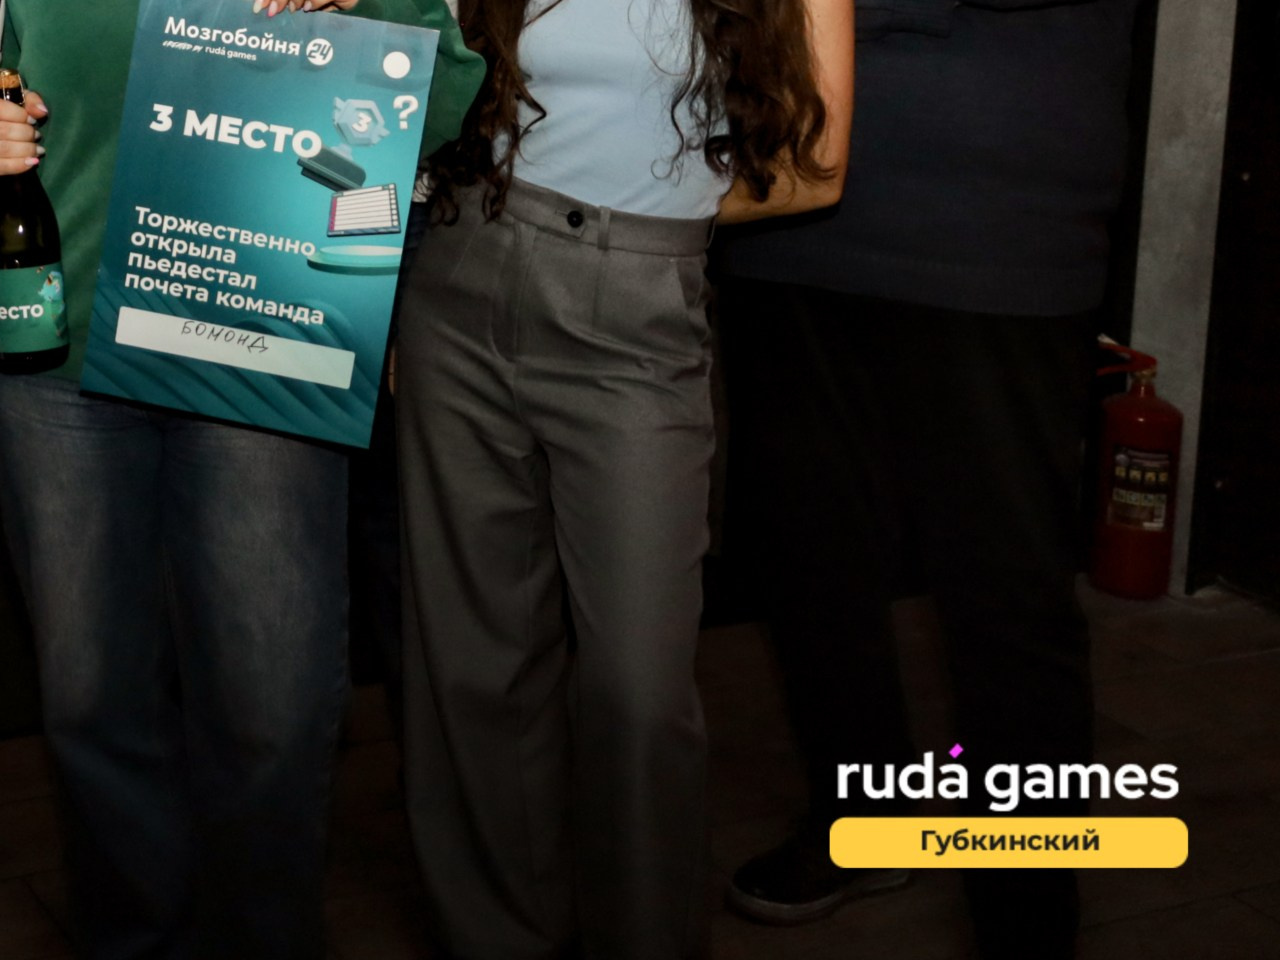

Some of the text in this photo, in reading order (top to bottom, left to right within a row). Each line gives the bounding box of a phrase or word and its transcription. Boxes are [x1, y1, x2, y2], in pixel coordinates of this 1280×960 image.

[164, 16, 333, 61] Мозгобойня 24
[227, 50, 257, 61] games
[149, 103, 322, 159] 3 МЕСТО
[352, 111, 373, 133] 3
[131, 231, 237, 264] открыла
[135, 205, 316, 258] Торжественно
[128, 251, 257, 290] пьедестал
[124, 273, 325, 325] почета команда
[181, 320, 269, 353] БОМОНД
